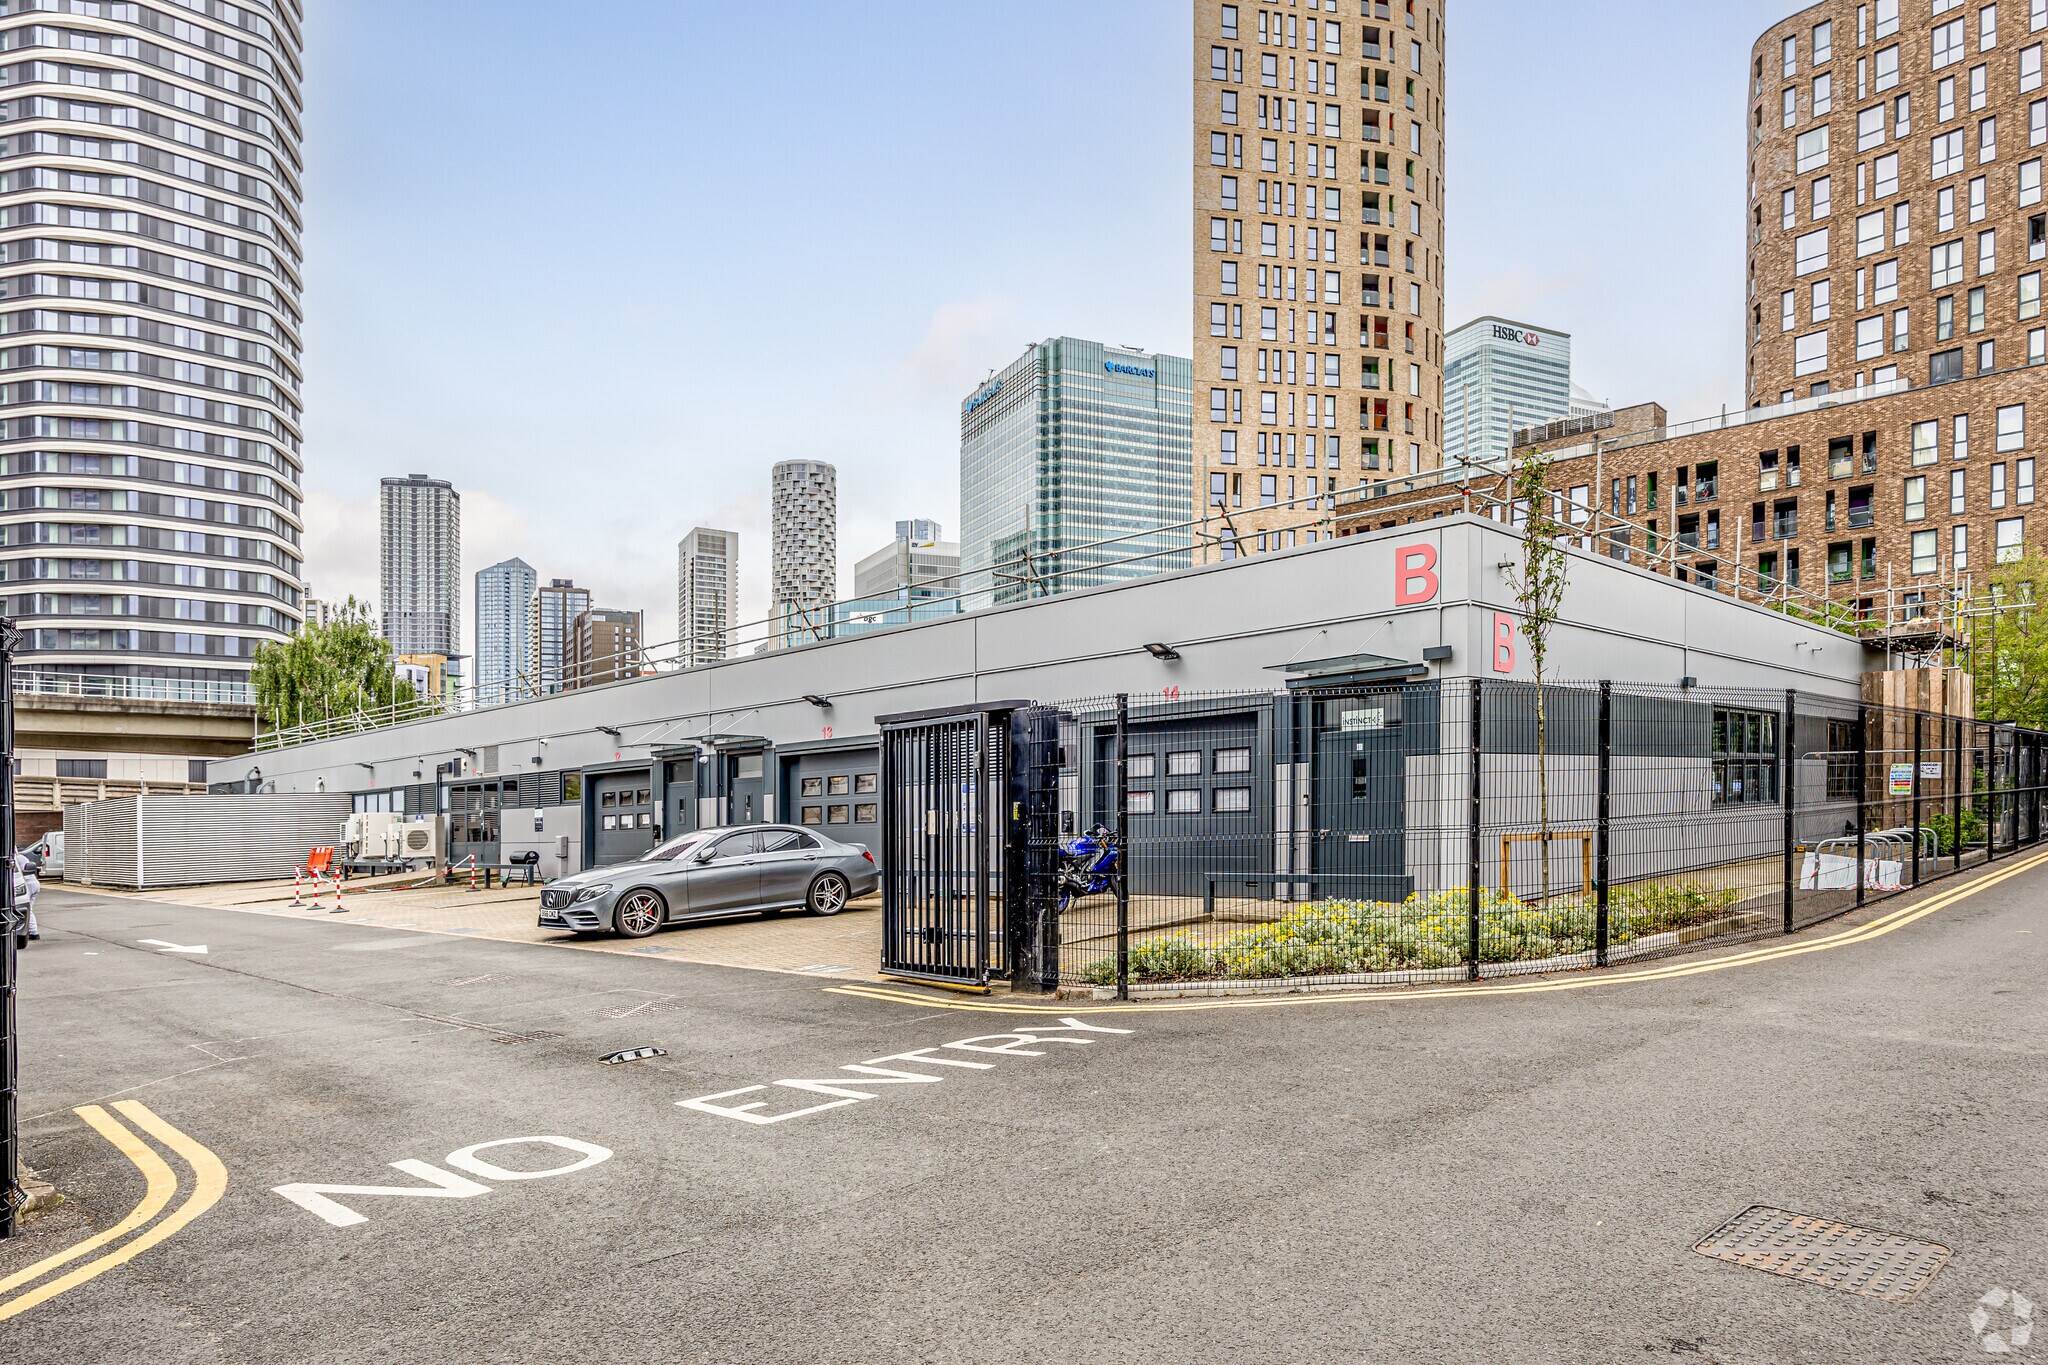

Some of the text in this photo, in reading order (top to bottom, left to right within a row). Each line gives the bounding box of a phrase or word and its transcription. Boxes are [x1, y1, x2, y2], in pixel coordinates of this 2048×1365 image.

[1492, 324, 1523, 343] HSBC
[1114, 363, 1155, 379] BARCLAYS
[1395, 543, 1439, 607] B
[1493, 612, 1516, 673] B
[1162, 684, 1179, 702] 14
[821, 725, 833, 739] 13
[272, 1017, 1134, 1227] NO ENTRY
